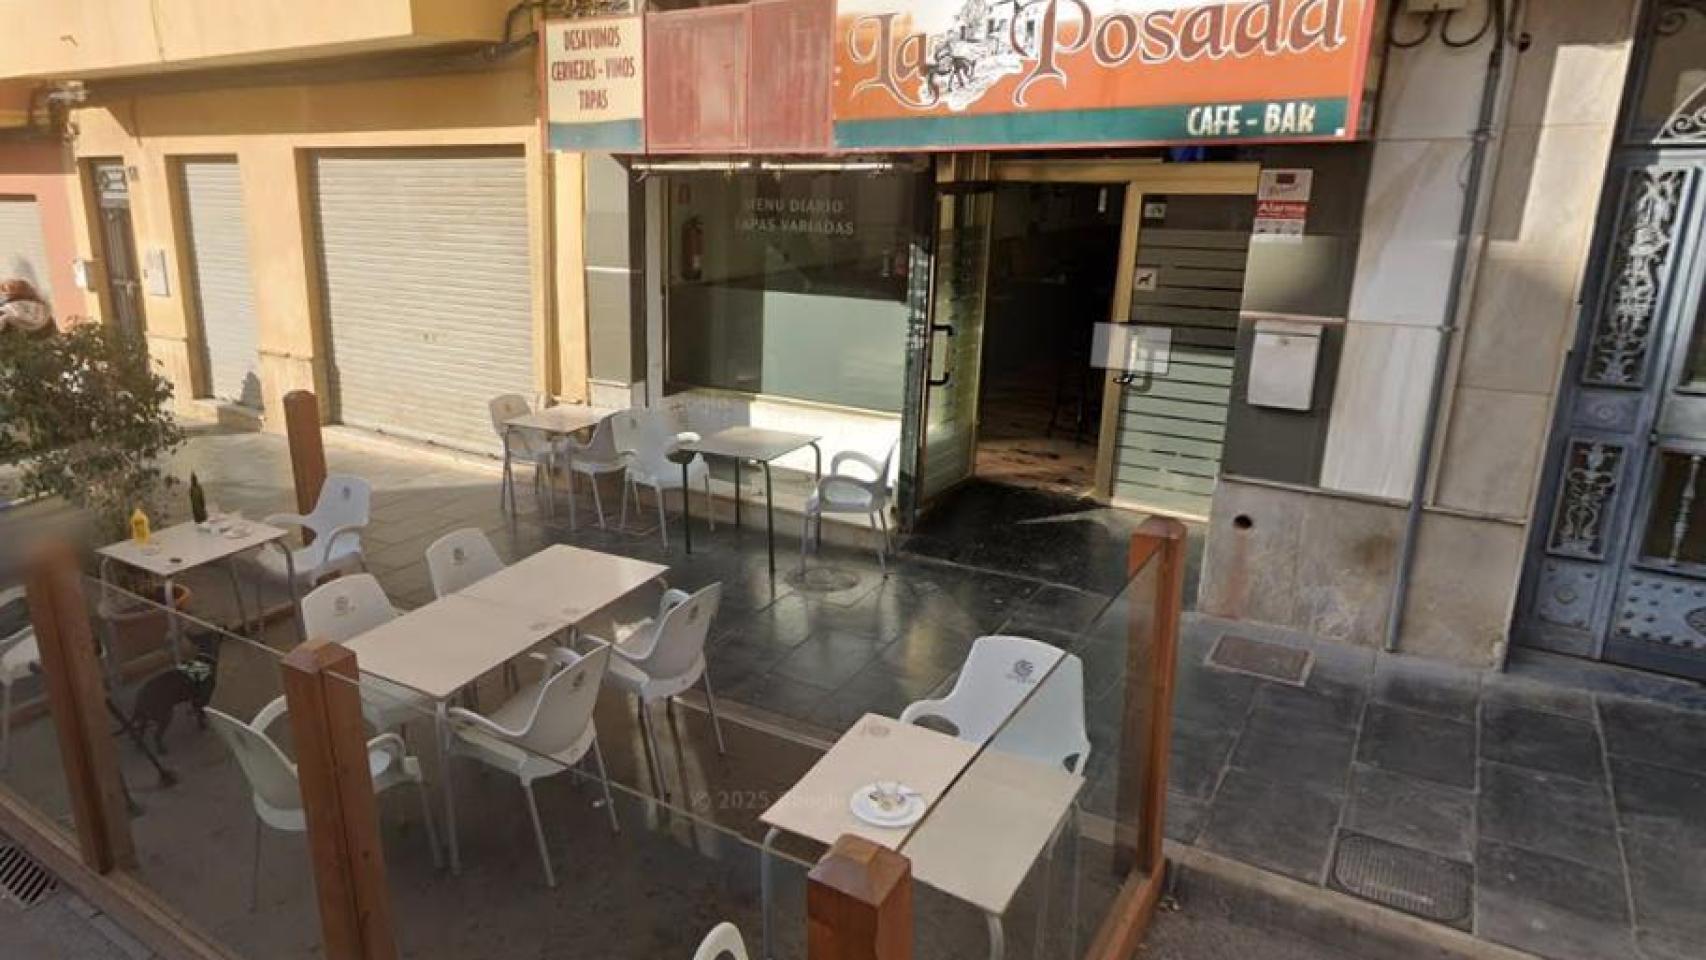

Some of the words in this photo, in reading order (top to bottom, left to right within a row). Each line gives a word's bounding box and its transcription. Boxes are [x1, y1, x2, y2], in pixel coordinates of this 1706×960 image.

[564, 26, 621, 51] DESAYUNOS
[849, 12, 940, 107] La
[1010, 0, 1345, 107] Posada
[551, 60, 596, 81] CERVEZAS
[606, 56, 635, 80] VINOS
[579, 89, 608, 112] TAPAS
[1187, 105, 1240, 136] CAFE
[1264, 103, 1316, 134] BAR
